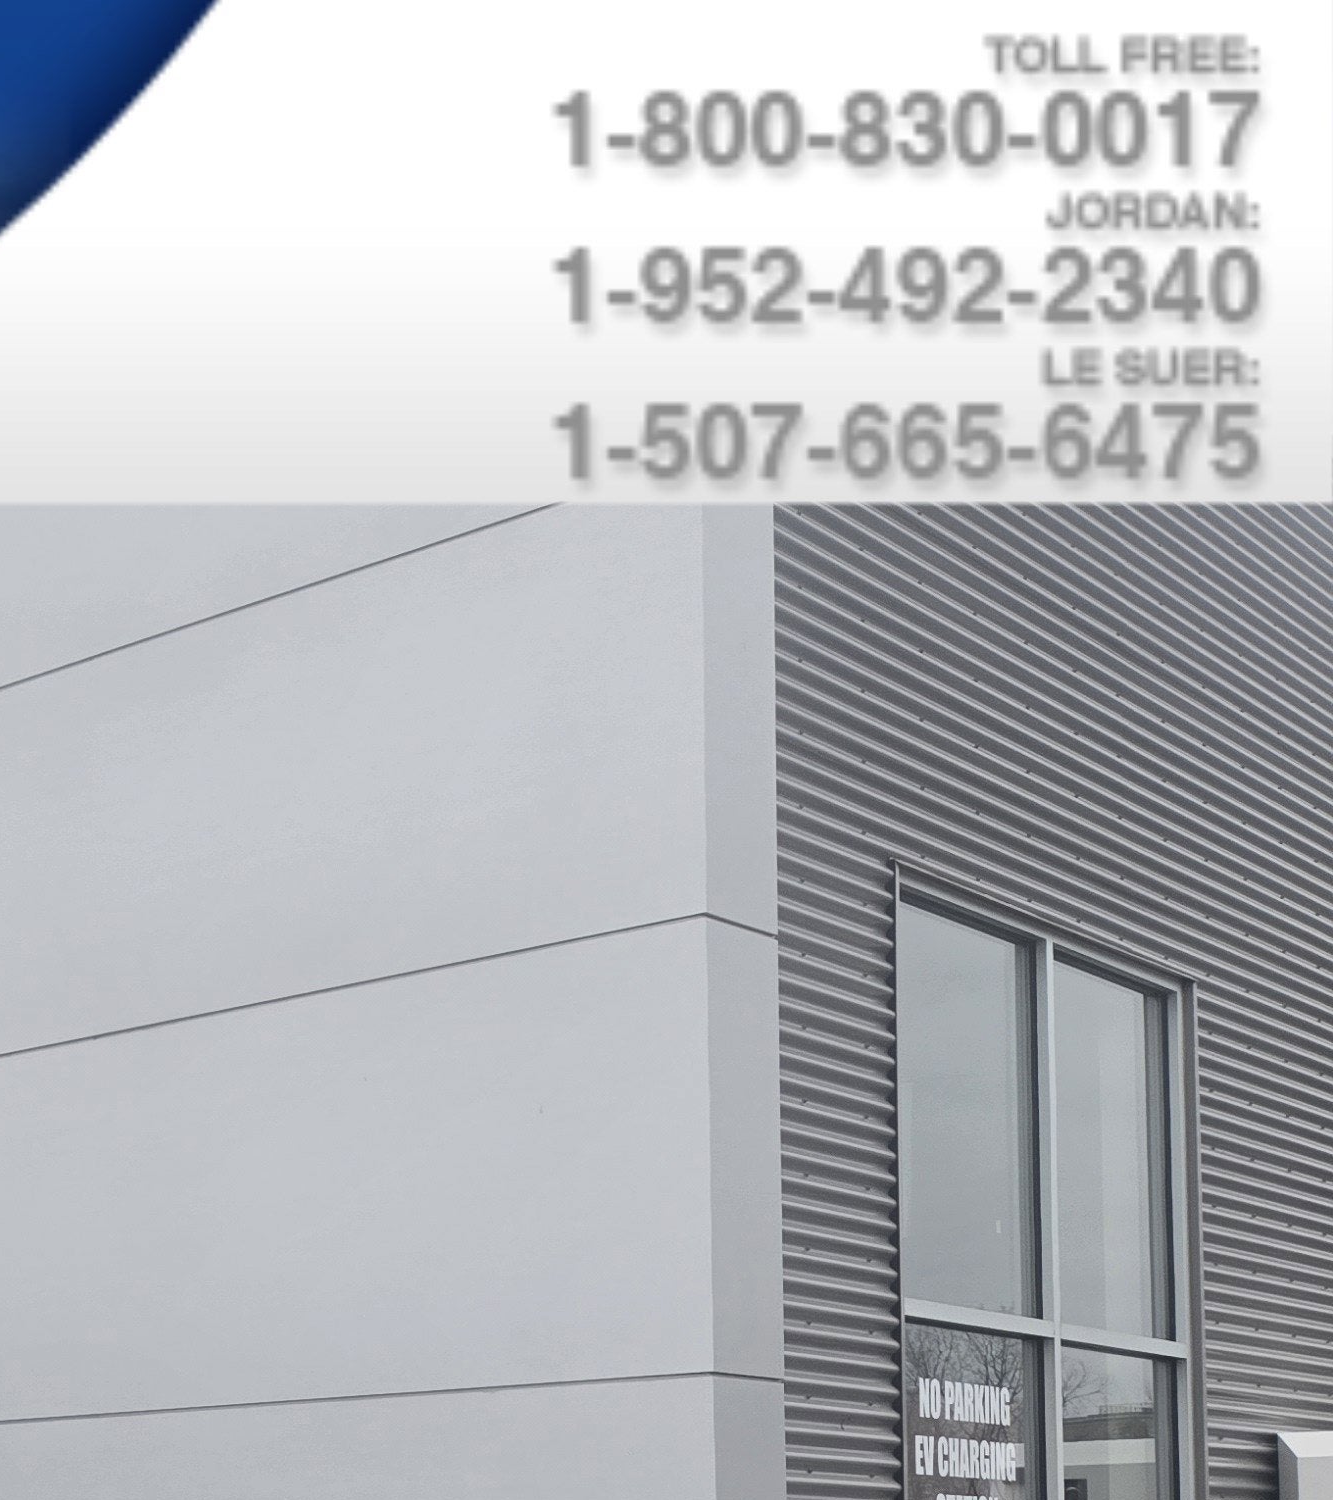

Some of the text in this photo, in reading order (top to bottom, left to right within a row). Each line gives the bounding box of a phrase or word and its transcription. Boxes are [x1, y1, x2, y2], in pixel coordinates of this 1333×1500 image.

[918, 1376, 1011, 1427] NO PARKING
[914, 1434, 1017, 1482] EV CHARGING
